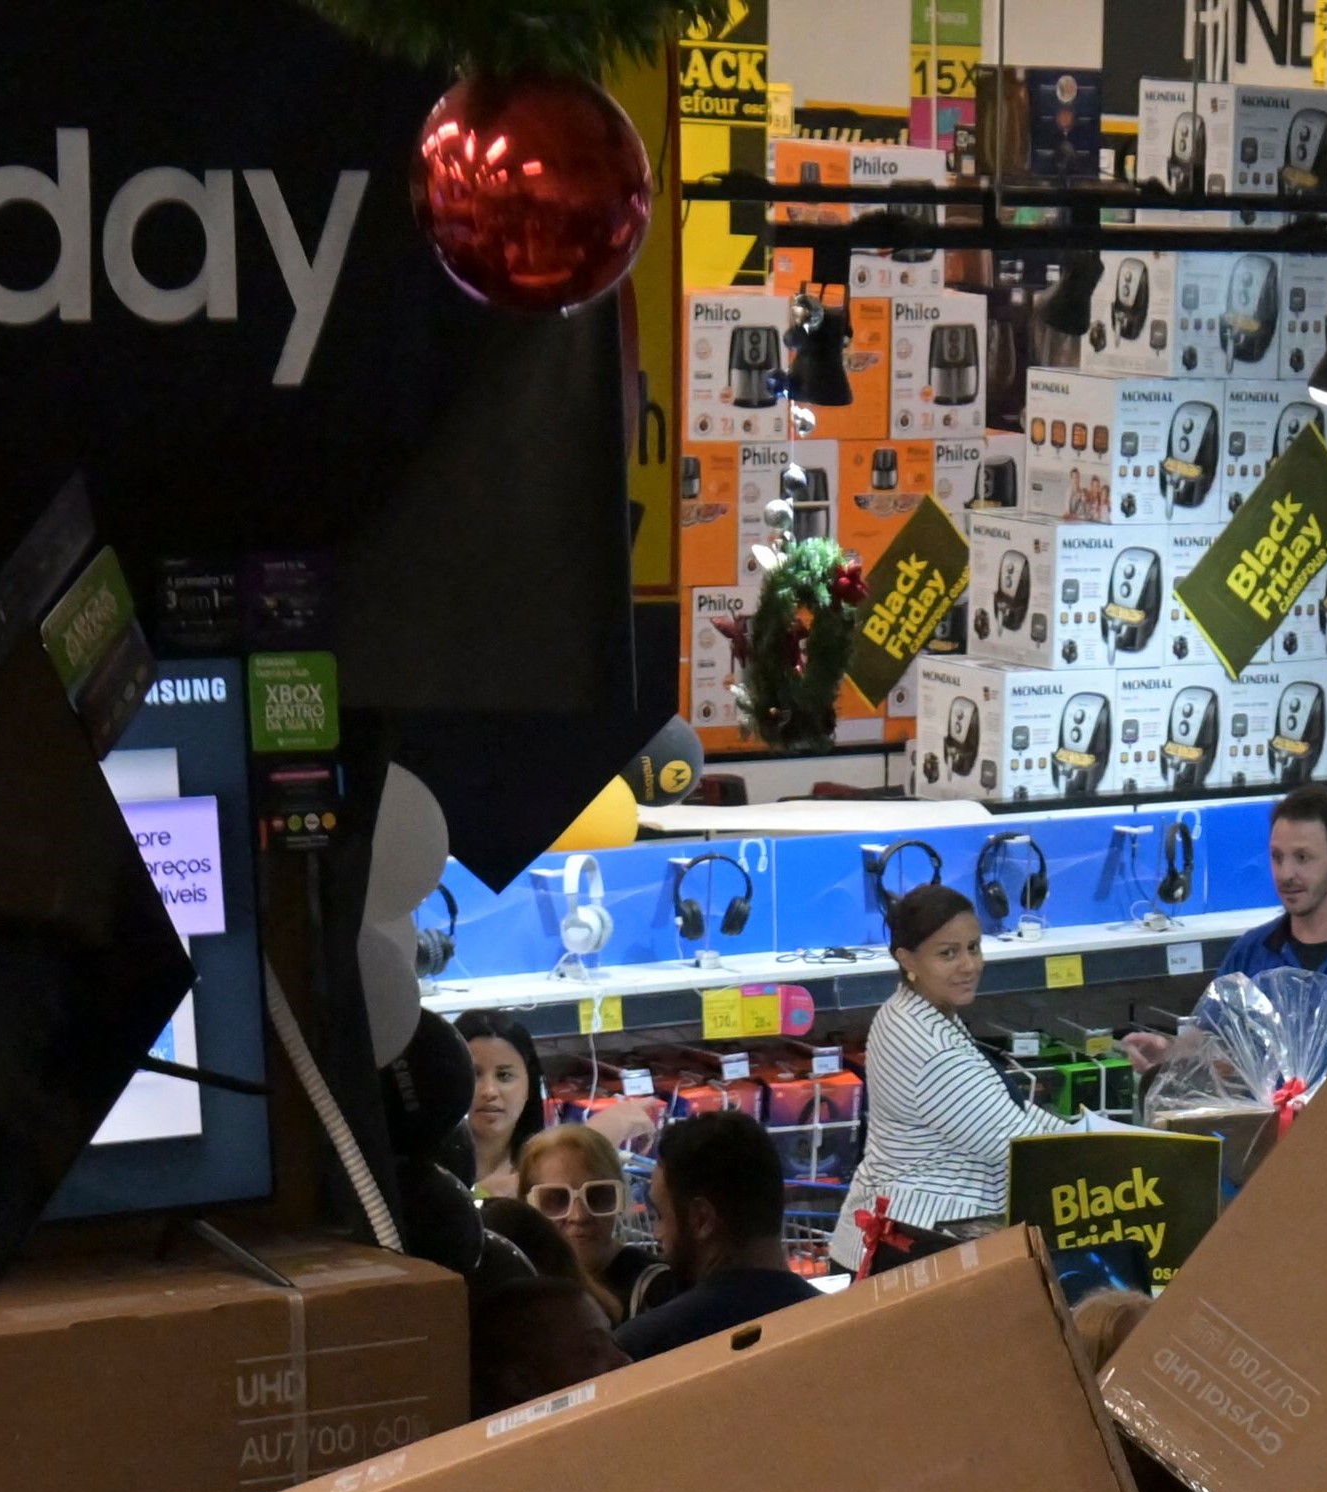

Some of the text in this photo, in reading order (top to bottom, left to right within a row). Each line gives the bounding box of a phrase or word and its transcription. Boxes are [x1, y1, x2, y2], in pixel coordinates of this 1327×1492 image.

[681, 49, 767, 91] ACK
[914, 59, 978, 97] 15X
[681, 89, 739, 116] efour
[853, 156, 899, 176] Philco
[694, 303, 742, 323] Philco
[895, 302, 941, 321] Philco
[1121, 391, 1174, 403] MONDIAL
[1229, 391, 1281, 403] MONDIAL
[742, 445, 789, 466] Philco
[936, 445, 980, 464] Philco
[1062, 538, 1115, 550] MONDIAL
[1174, 536, 1216, 548] MONDI
[1226, 490, 1303, 603] Black
[1250, 514, 1324, 622] Friday
[697, 594, 744, 614] Philco
[863, 553, 928, 647] Black
[885, 569, 946, 661] Friday
[144, 677, 227, 706] SUNG
[265, 684, 323, 704] XBOX
[1012, 684, 1066, 697] MONDIAL
[1121, 678, 1175, 691] MONDIAL
[265, 704, 325, 720] DENTRO
[146, 858, 212, 880] reços
[1051, 1166, 1165, 1227] Black
[236, 1369, 306, 1409] UHD
[1152, 1347, 1283, 1456] Crystal UHD
